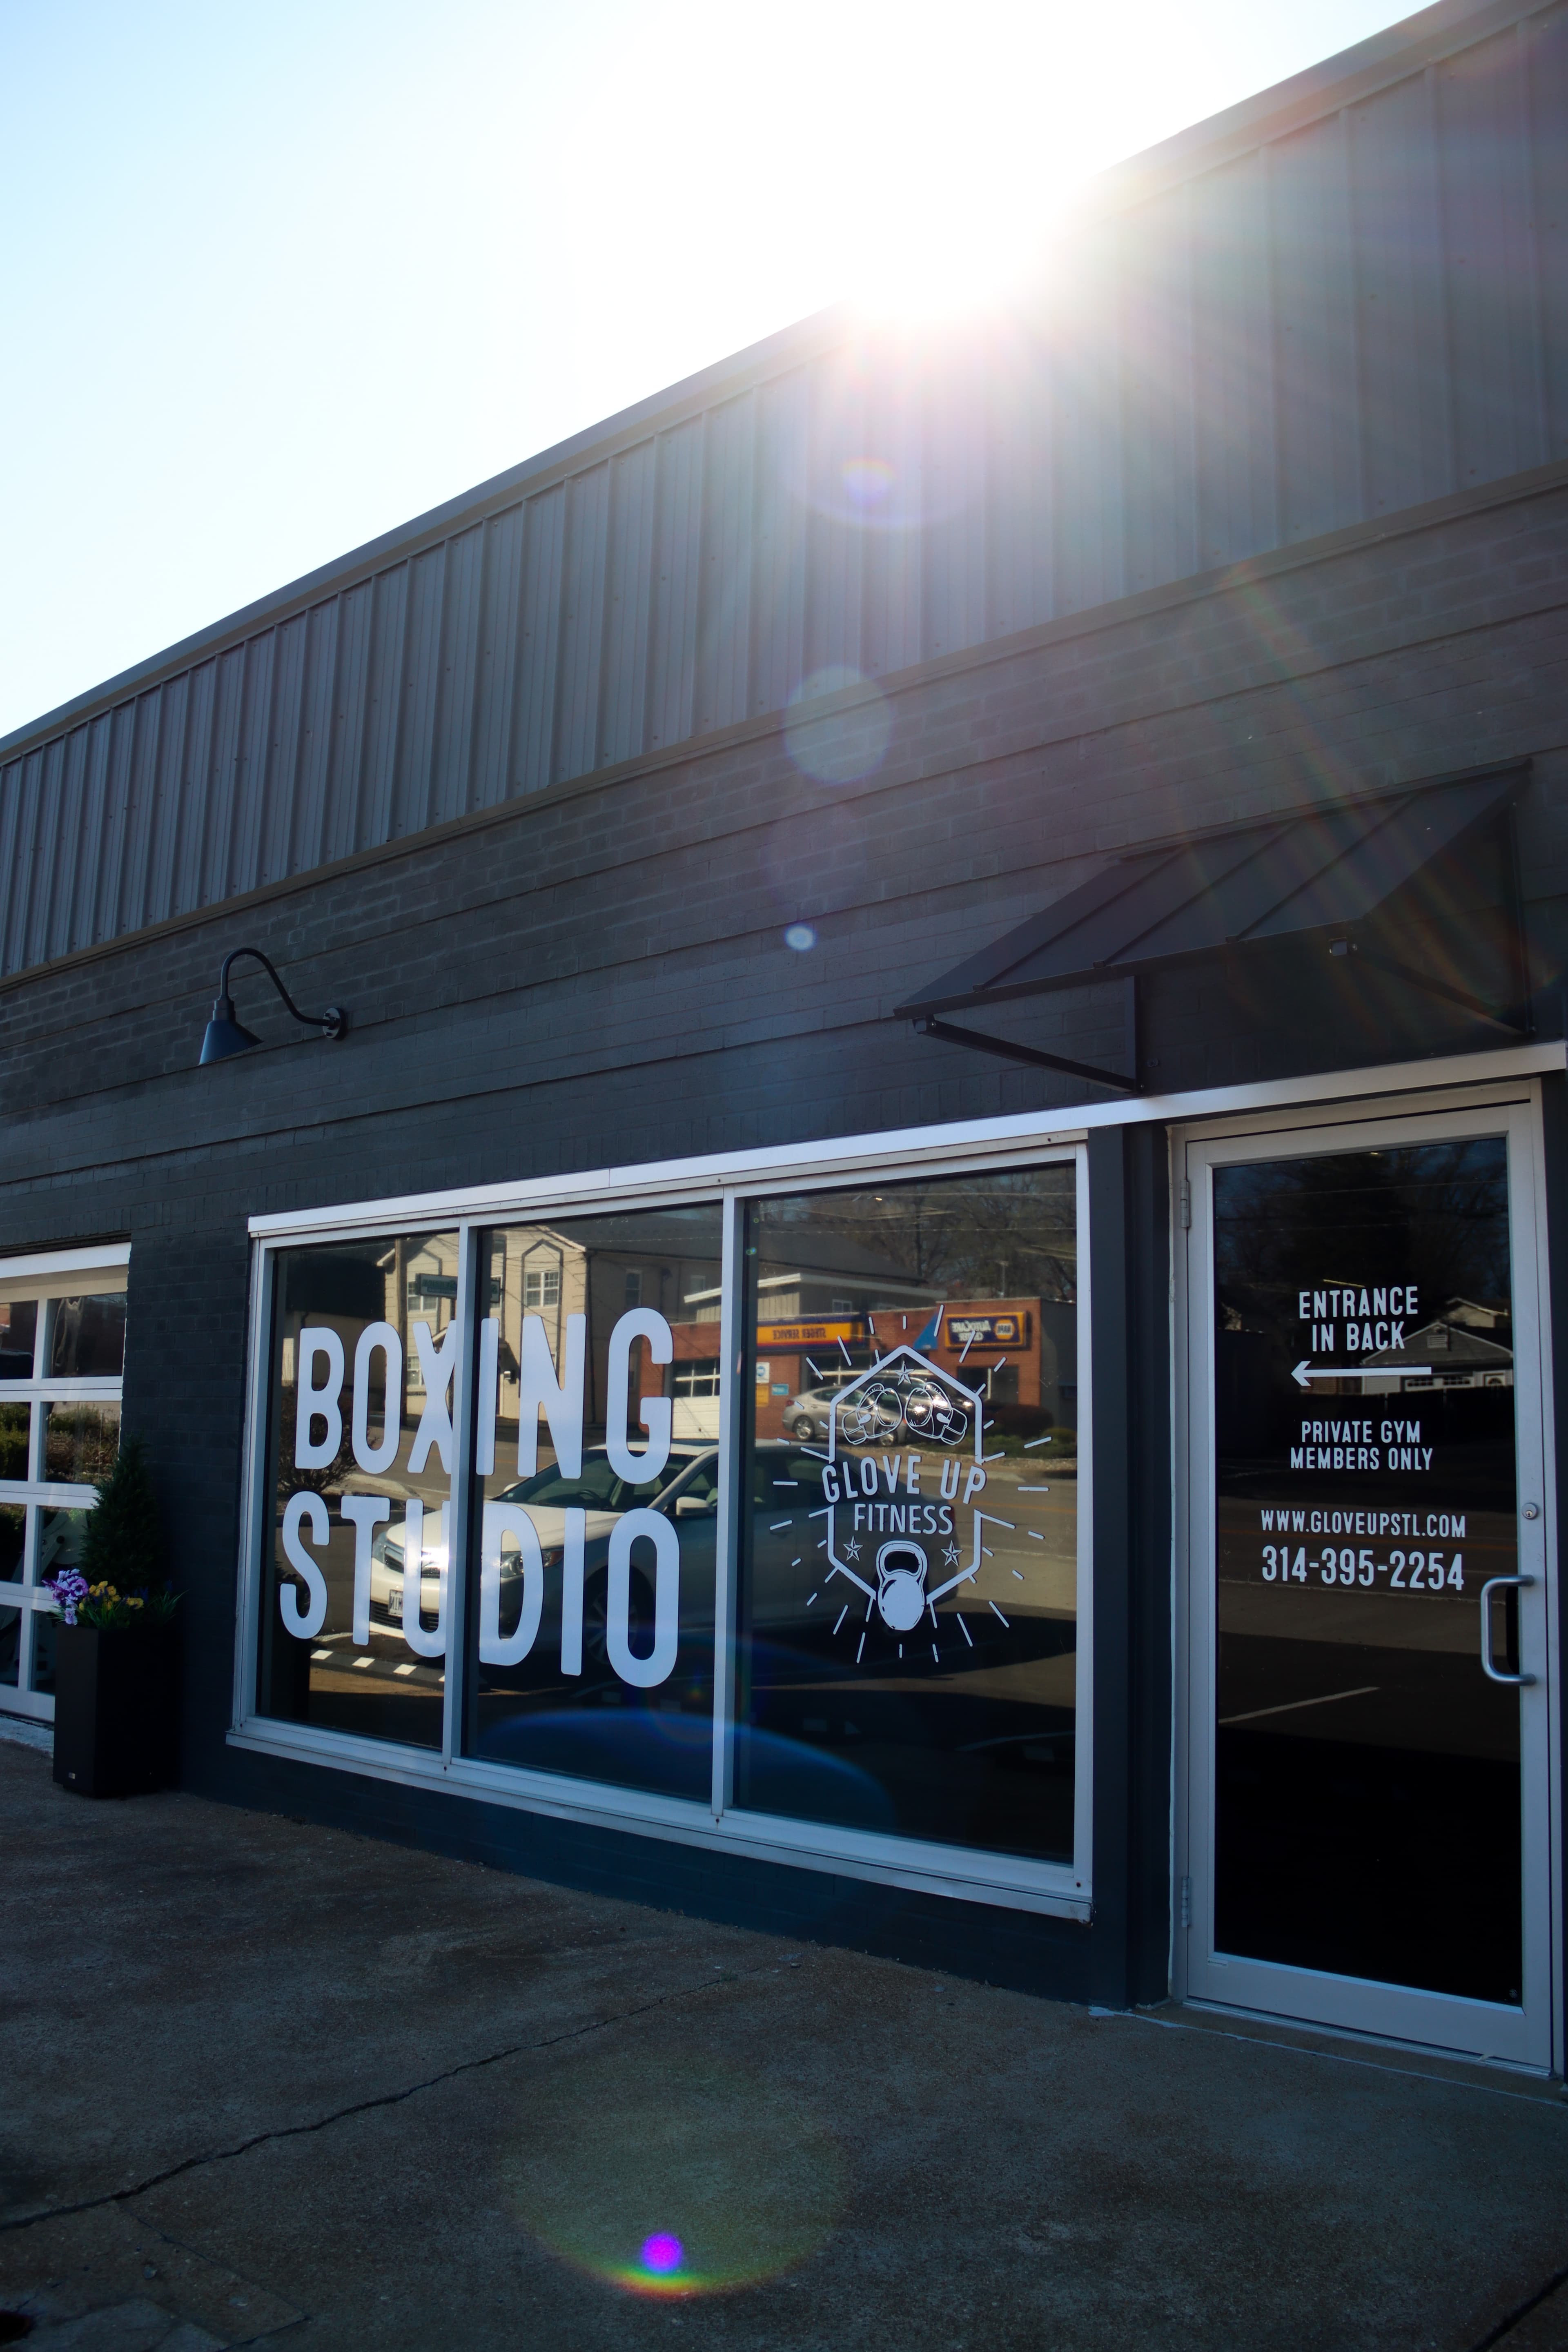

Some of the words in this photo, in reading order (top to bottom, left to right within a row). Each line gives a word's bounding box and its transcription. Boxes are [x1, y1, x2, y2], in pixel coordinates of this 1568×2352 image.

[1299, 1286, 1418, 1319] ENTRANCE
[1312, 1324, 1334, 1352] IN
[1347, 1321, 1405, 1351] BACK
[295, 1308, 673, 1484] BOXING
[1302, 1421, 1372, 1443] PRIVATE
[1381, 1421, 1420, 1443] GYM
[1291, 1447, 1379, 1470] MEMBERS
[1388, 1448, 1433, 1470] ONLY
[822, 1455, 921, 1503] GLOVE
[940, 1461, 986, 1503] UP
[854, 1503, 953, 1535] FITNESS
[1261, 1510, 1465, 1538] WWW.GLOVEUPSTL.COM
[1262, 1545, 1464, 1590] 314-395-2254
[280, 1491, 679, 1688] STUDIO
